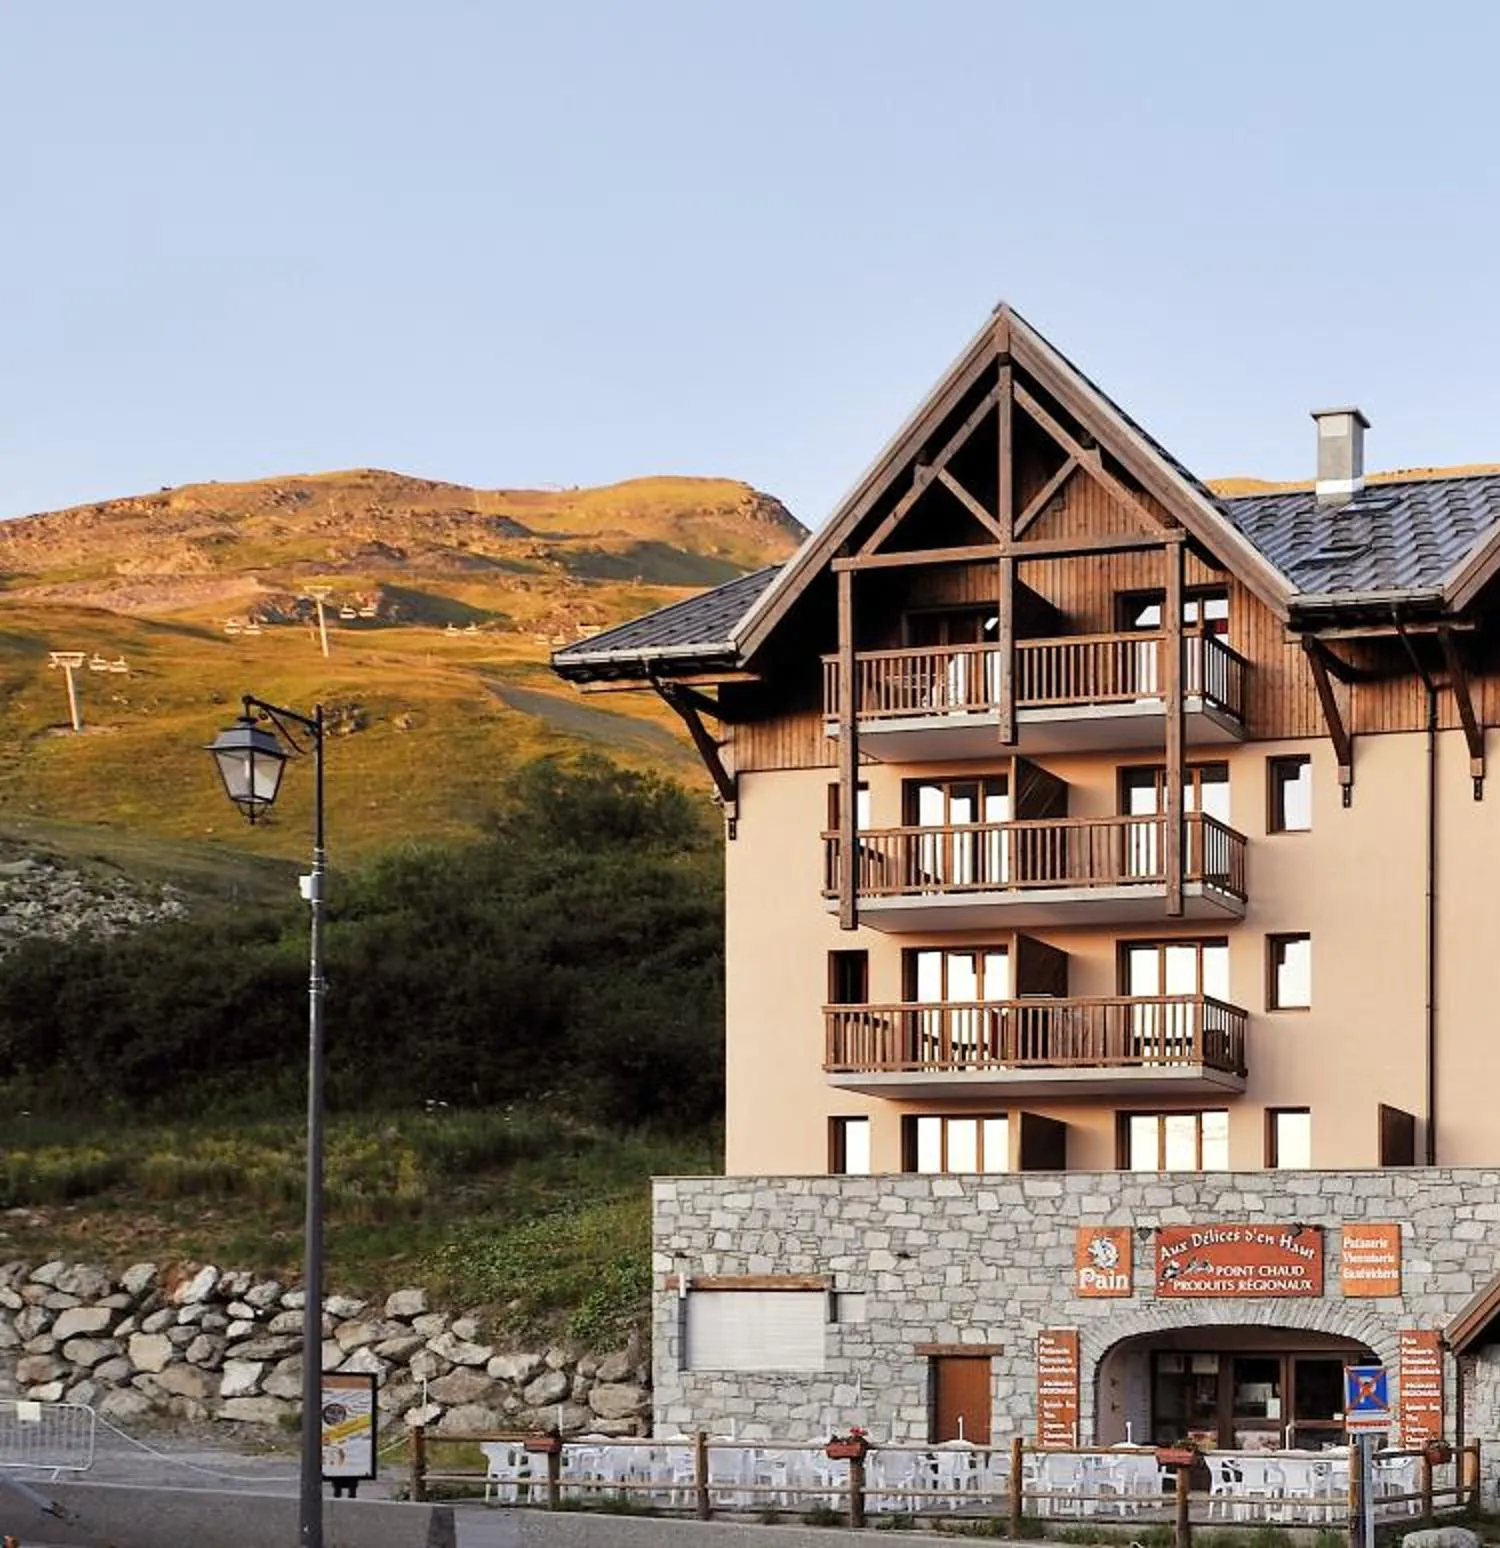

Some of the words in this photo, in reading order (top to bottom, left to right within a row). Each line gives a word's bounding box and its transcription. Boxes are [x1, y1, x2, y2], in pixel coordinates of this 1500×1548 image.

[1160, 1240, 1188, 1261] Aux
[1191, 1228, 1240, 1247] Délices
[1244, 1228, 1275, 1244] d'en
[1279, 1234, 1315, 1260] Haut
[1079, 1267, 1129, 1290] Pain
[1216, 1265, 1255, 1276] POINT
[1258, 1265, 1305, 1276] CHAUD
[1172, 1279, 1235, 1291] PRODUITS
